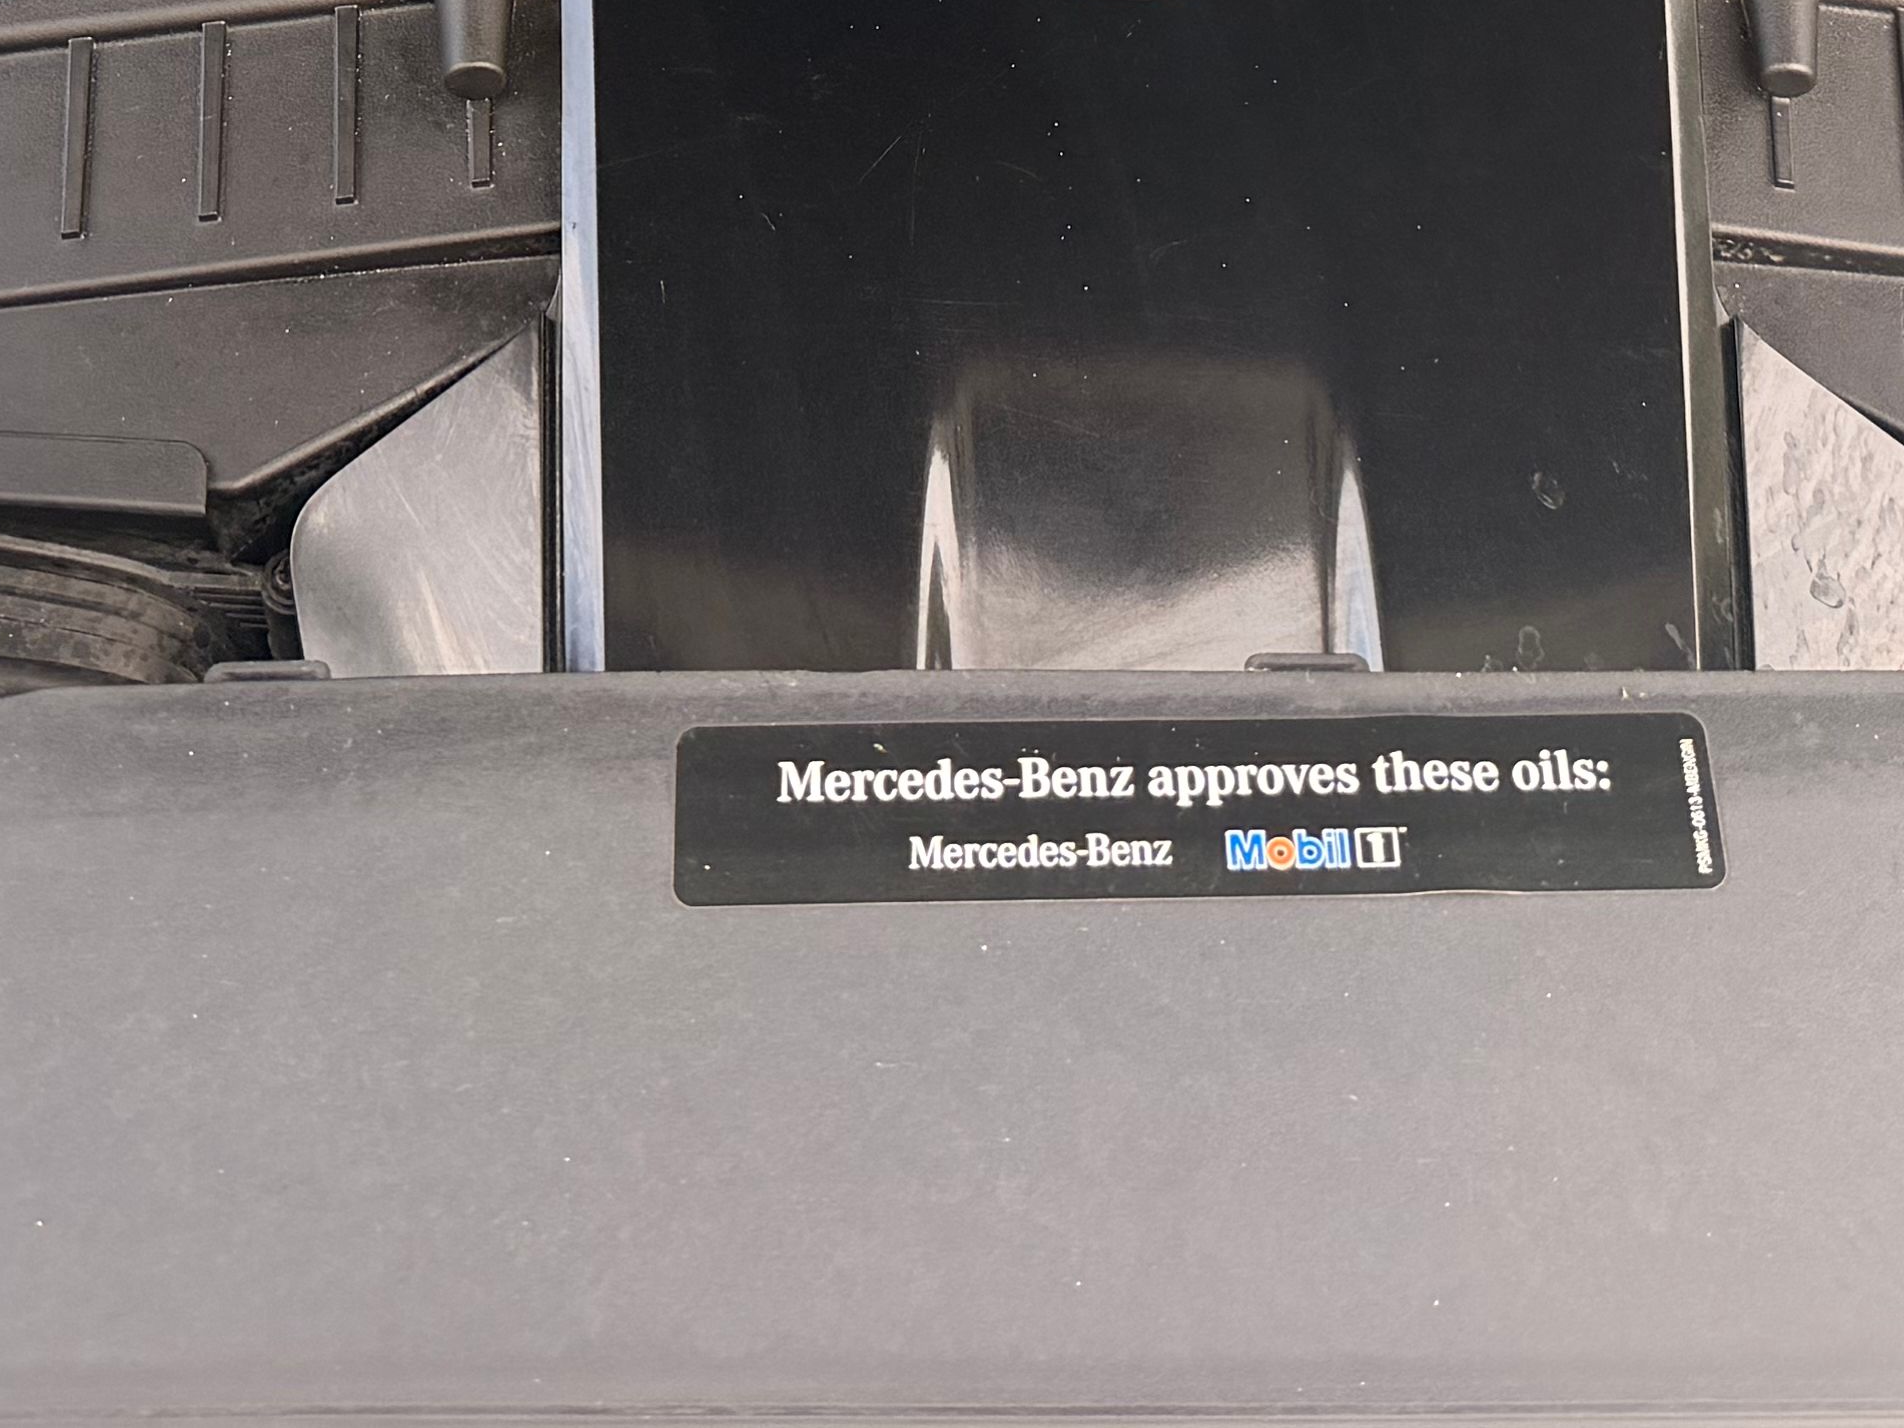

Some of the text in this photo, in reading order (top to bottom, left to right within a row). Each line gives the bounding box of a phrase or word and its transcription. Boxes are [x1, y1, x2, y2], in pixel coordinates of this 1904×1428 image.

[776, 748, 1612, 808] Mercedes-Benz approves these oils:
[908, 832, 1173, 870] Mercedes-Benz
[1224, 828, 1352, 872] Mobil
